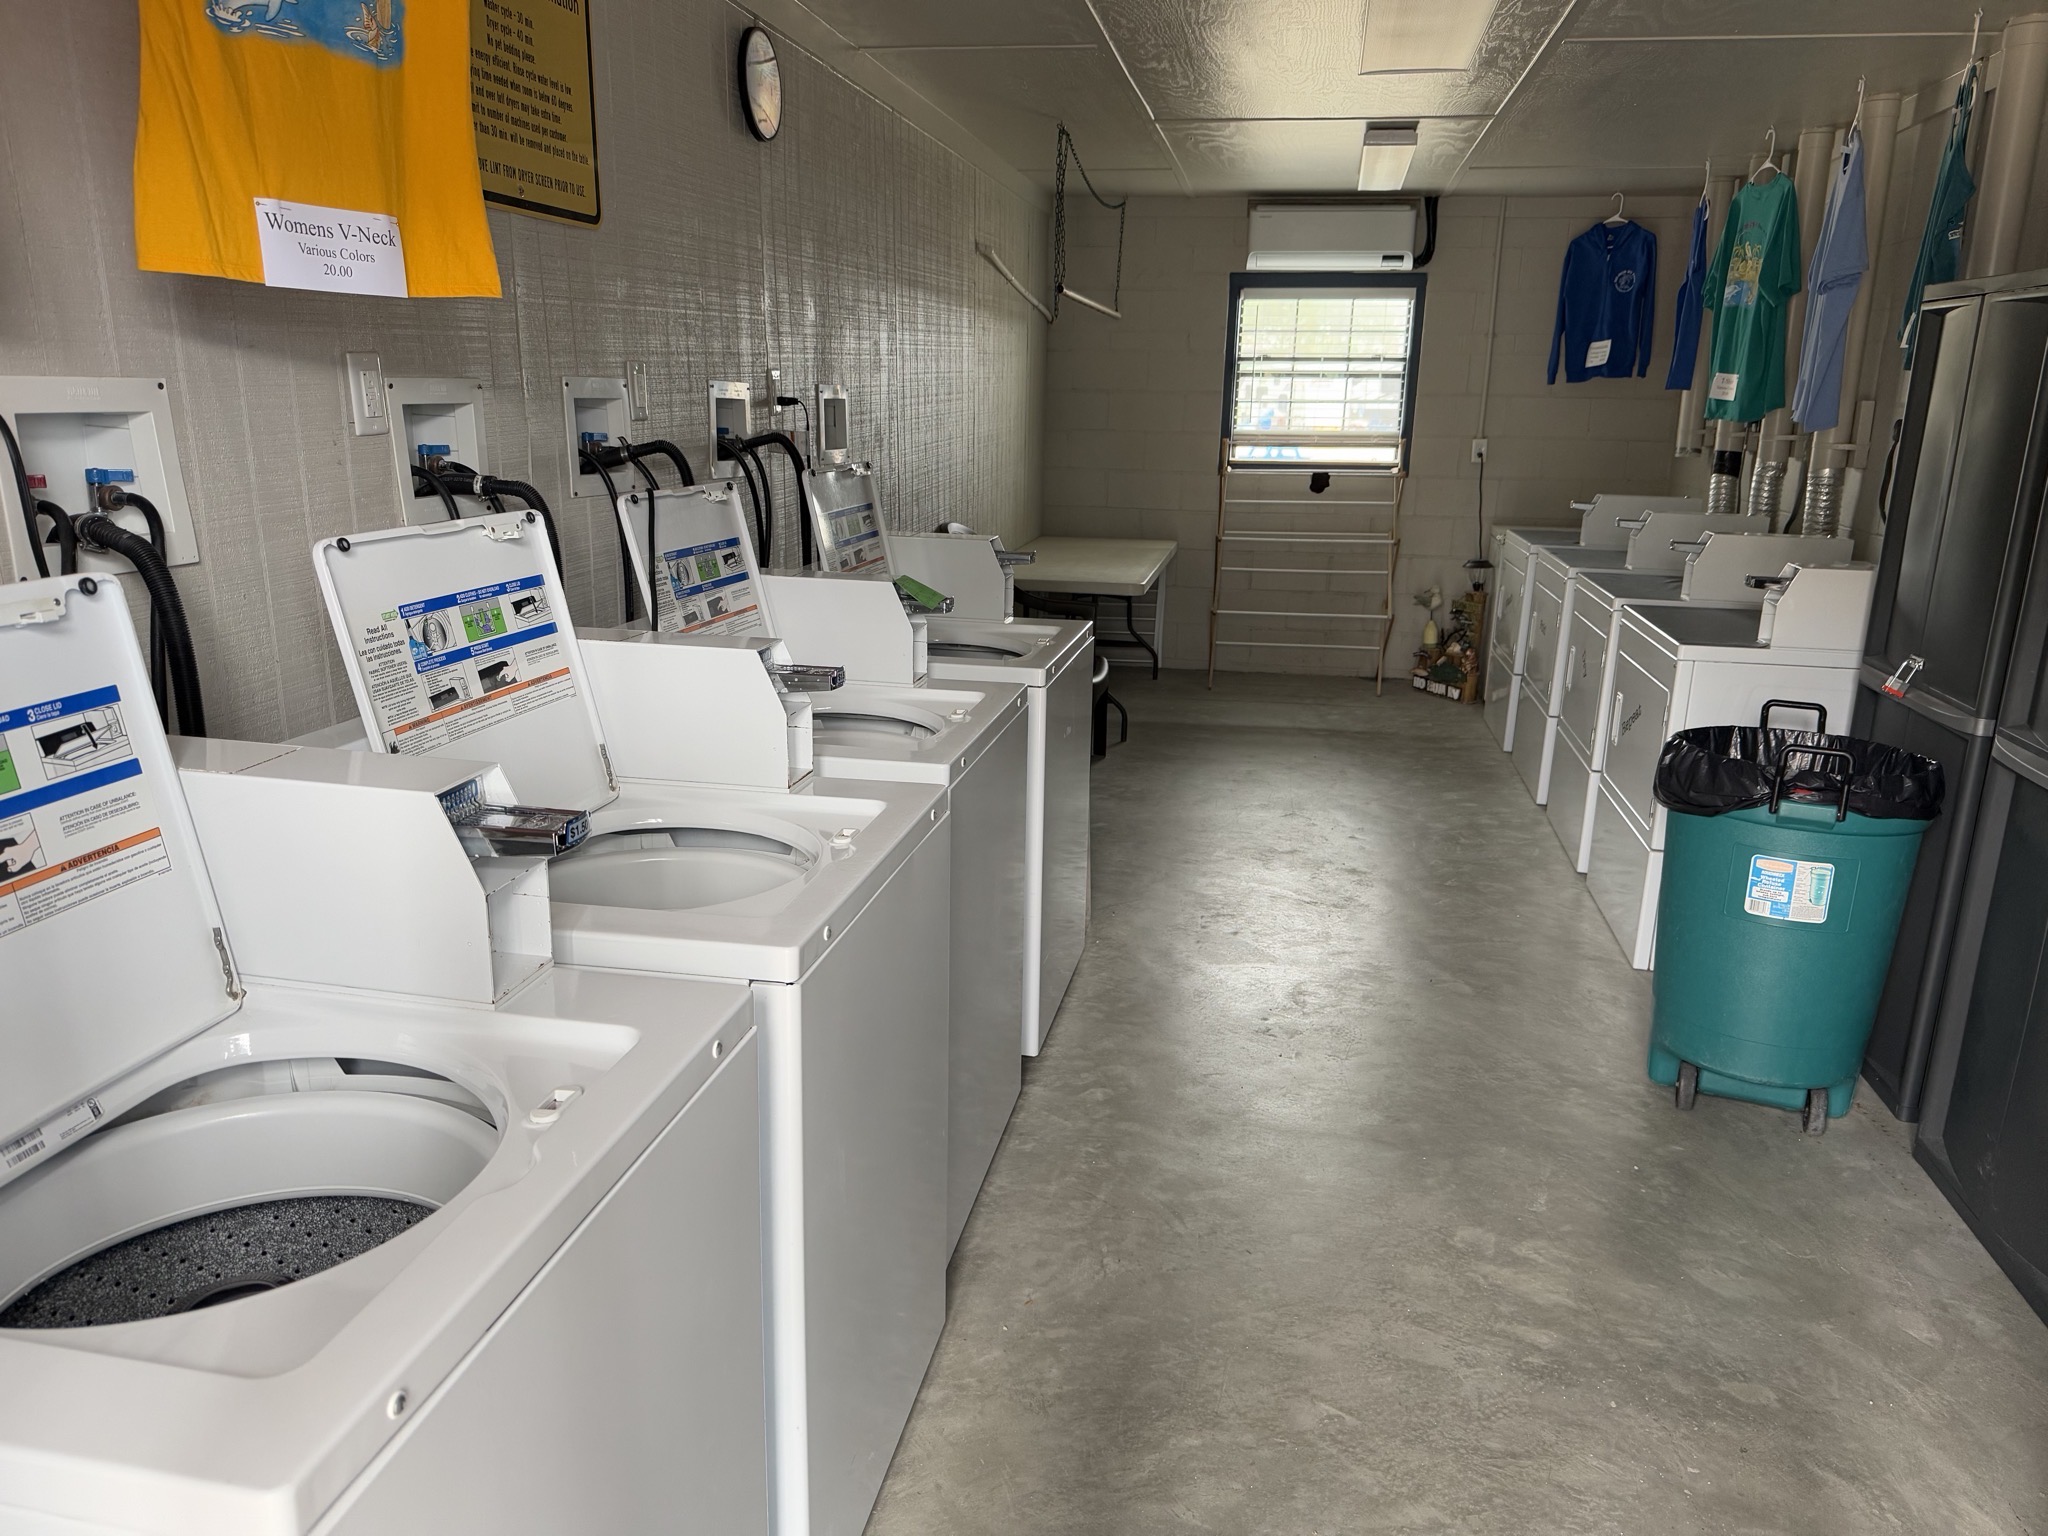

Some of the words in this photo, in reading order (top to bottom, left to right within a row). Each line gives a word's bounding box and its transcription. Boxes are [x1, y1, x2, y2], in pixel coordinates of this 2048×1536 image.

[500, 6, 512, 20] cycle
[516, 11, 522, 25] 30
[524, 16, 534, 30] min.
[486, 14, 498, 32] Dryer
[500, 23, 512, 37] cycle
[516, 28, 522, 42] 40
[524, 33, 534, 47] min.
[486, 33, 493, 47] No
[494, 38, 502, 51] pet
[503, 40, 520, 61] bedding
[475, 49, 490, 66] energy
[492, 54, 510, 72] efficient.
[525, 69, 536, 82] cycle
[537, 74, 548, 86] water
[549, 77, 558, 91] level
[481, 67, 491, 82] time
[493, 74, 508, 88] needed
[509, 79, 520, 93] when
[521, 85, 532, 97] room
[538, 89, 550, 104] below
[551, 94, 557, 106] 60
[558, 97, 574, 113] degrees.
[475, 85, 484, 97] and
[485, 89, 494, 101] over
[505, 94, 519, 110] dryers
[520, 102, 529, 116] may
[530, 103, 539, 117] take
[540, 108, 550, 121] extra
[551, 111, 561, 124] time.
[480, 102, 485, 116] to
[486, 108, 503, 121] number
[504, 112, 509, 124] of
[510, 116, 530, 130] machines
[531, 122, 540, 134] used
[479, 120, 489, 135] than
[490, 124, 497, 138] 30
[498, 128, 509, 141] min.
[510, 131, 518, 143] will
[519, 133, 524, 146] be
[525, 138, 542, 151] removed
[543, 143, 551, 154] and
[552, 145, 565, 158] placed
[489, 160, 501, 175] LINT
[502, 164, 516, 179] FROM
[517, 168, 534, 184] DRYER
[535, 173, 553, 189] SCREEN
[554, 178, 569, 193] PRIOR
[569, 182, 575, 195] TO
[264, 211, 334, 239] Womens
[337, 223, 397, 247] V-Neck
[298, 241, 337, 259] Various
[340, 248, 376, 263] Colors
[323, 263, 353, 278] 20.00
[363, 632, 394, 644] Instructions
[366, 626, 380, 635] Read
[380, 623, 388, 632] All
[27, 708, 36, 722] 3
[35, 705, 53, 715] CLOSE
[53, 701, 63, 711] LID
[59, 808, 84, 821] ATTENTION
[90, 801, 101, 811] CASE
[570, 819, 589, 839] $1.50
[68, 844, 120, 869] ADVERTENCIA
[1757, 882, 1786, 892] Container
